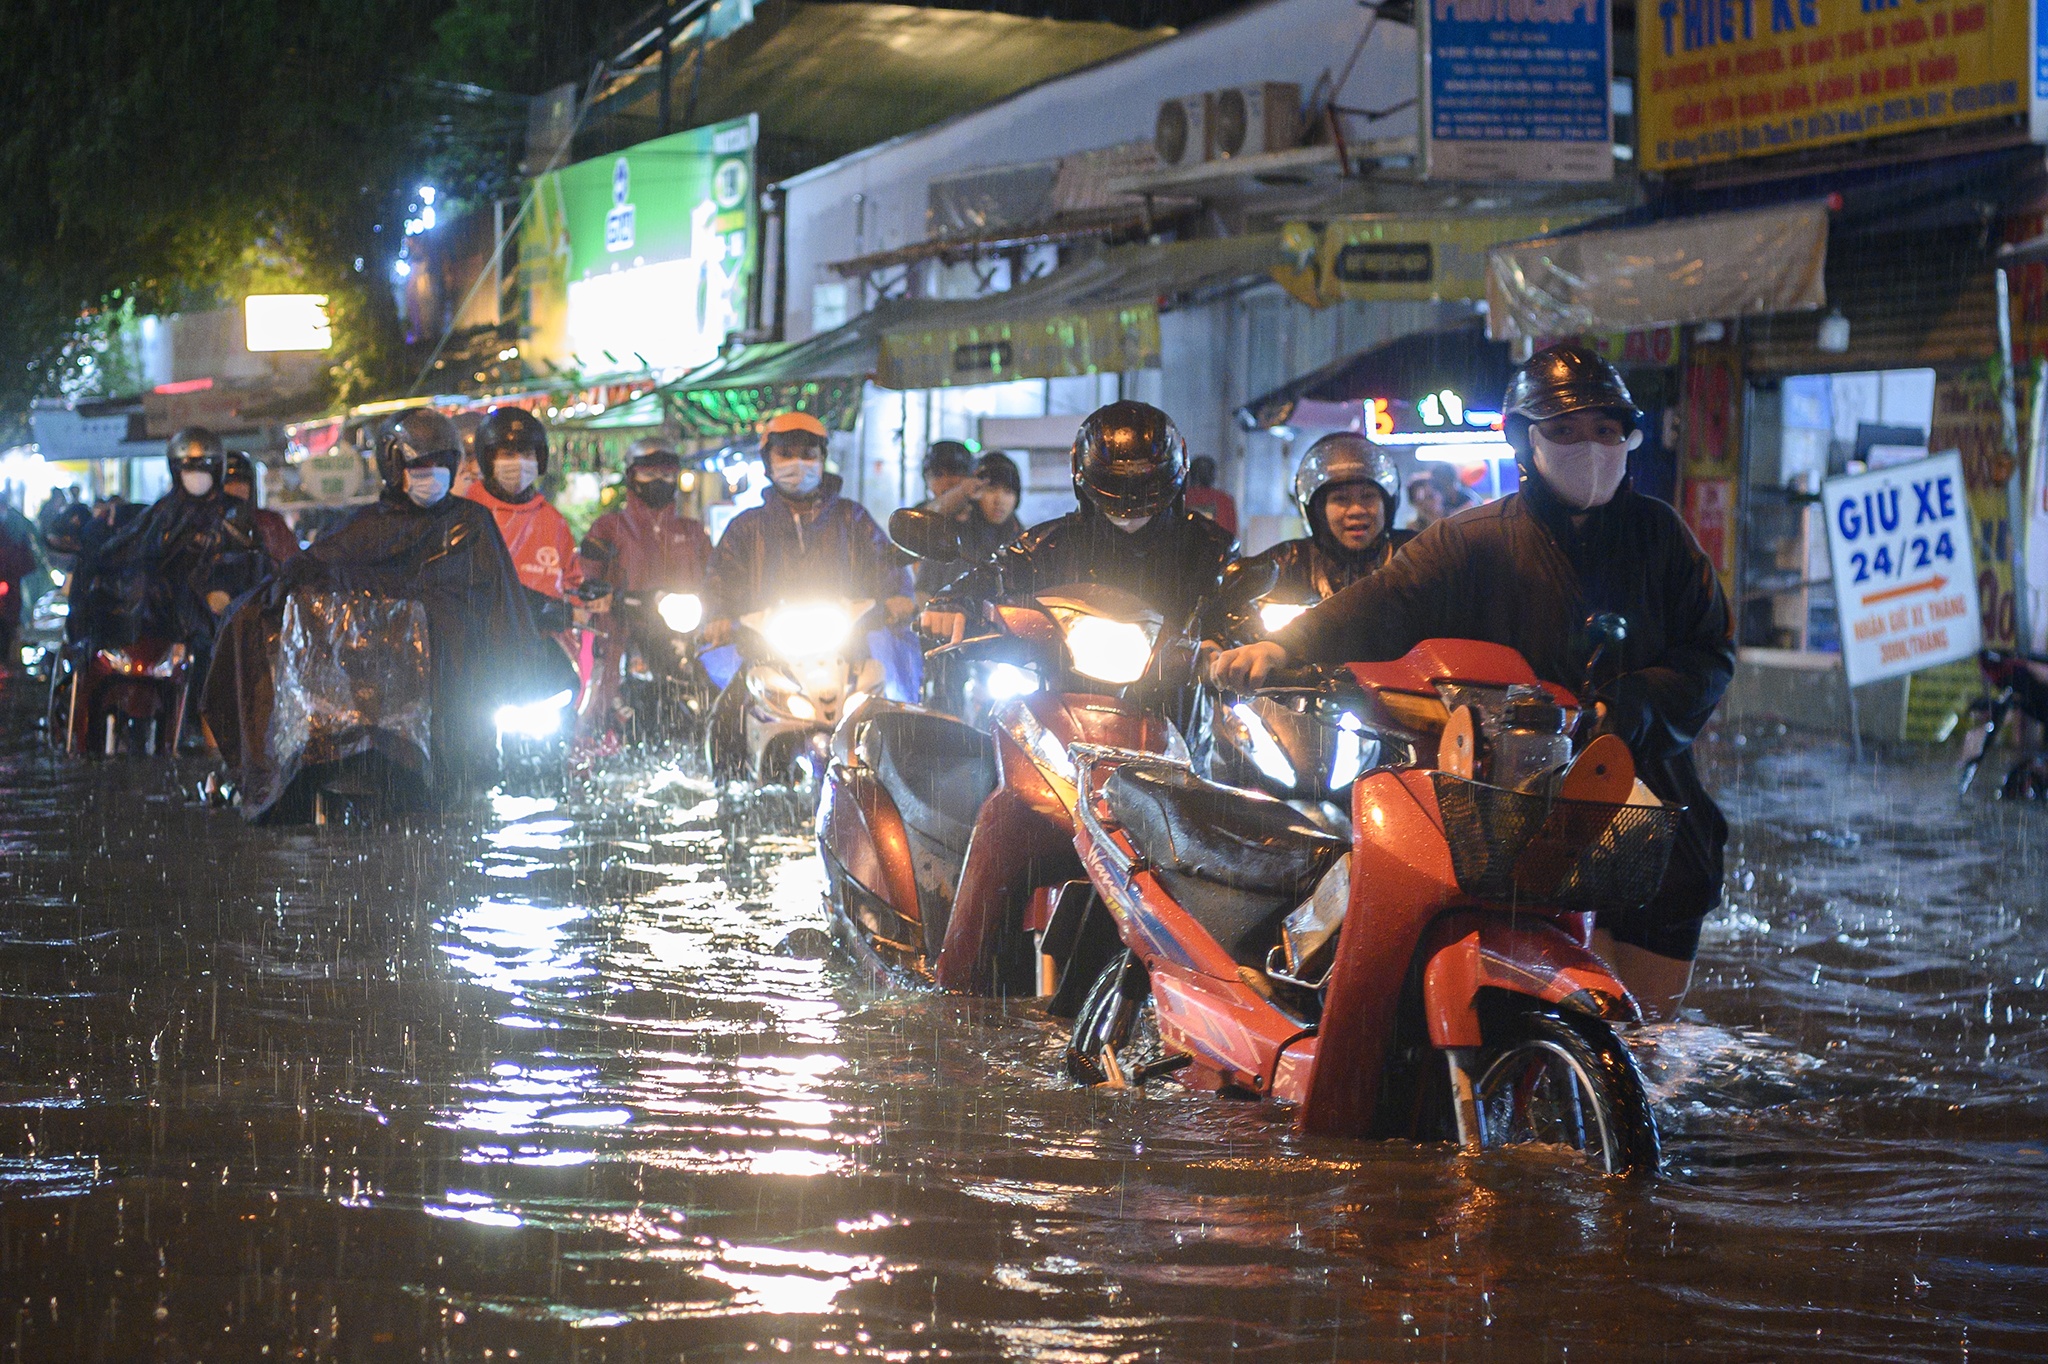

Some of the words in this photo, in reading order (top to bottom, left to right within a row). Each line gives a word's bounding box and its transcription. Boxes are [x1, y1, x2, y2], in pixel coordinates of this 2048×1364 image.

[1912, 476, 1956, 526] XE
[1850, 531, 1955, 585] 24/24
[1087, 840, 1121, 898] Wave
